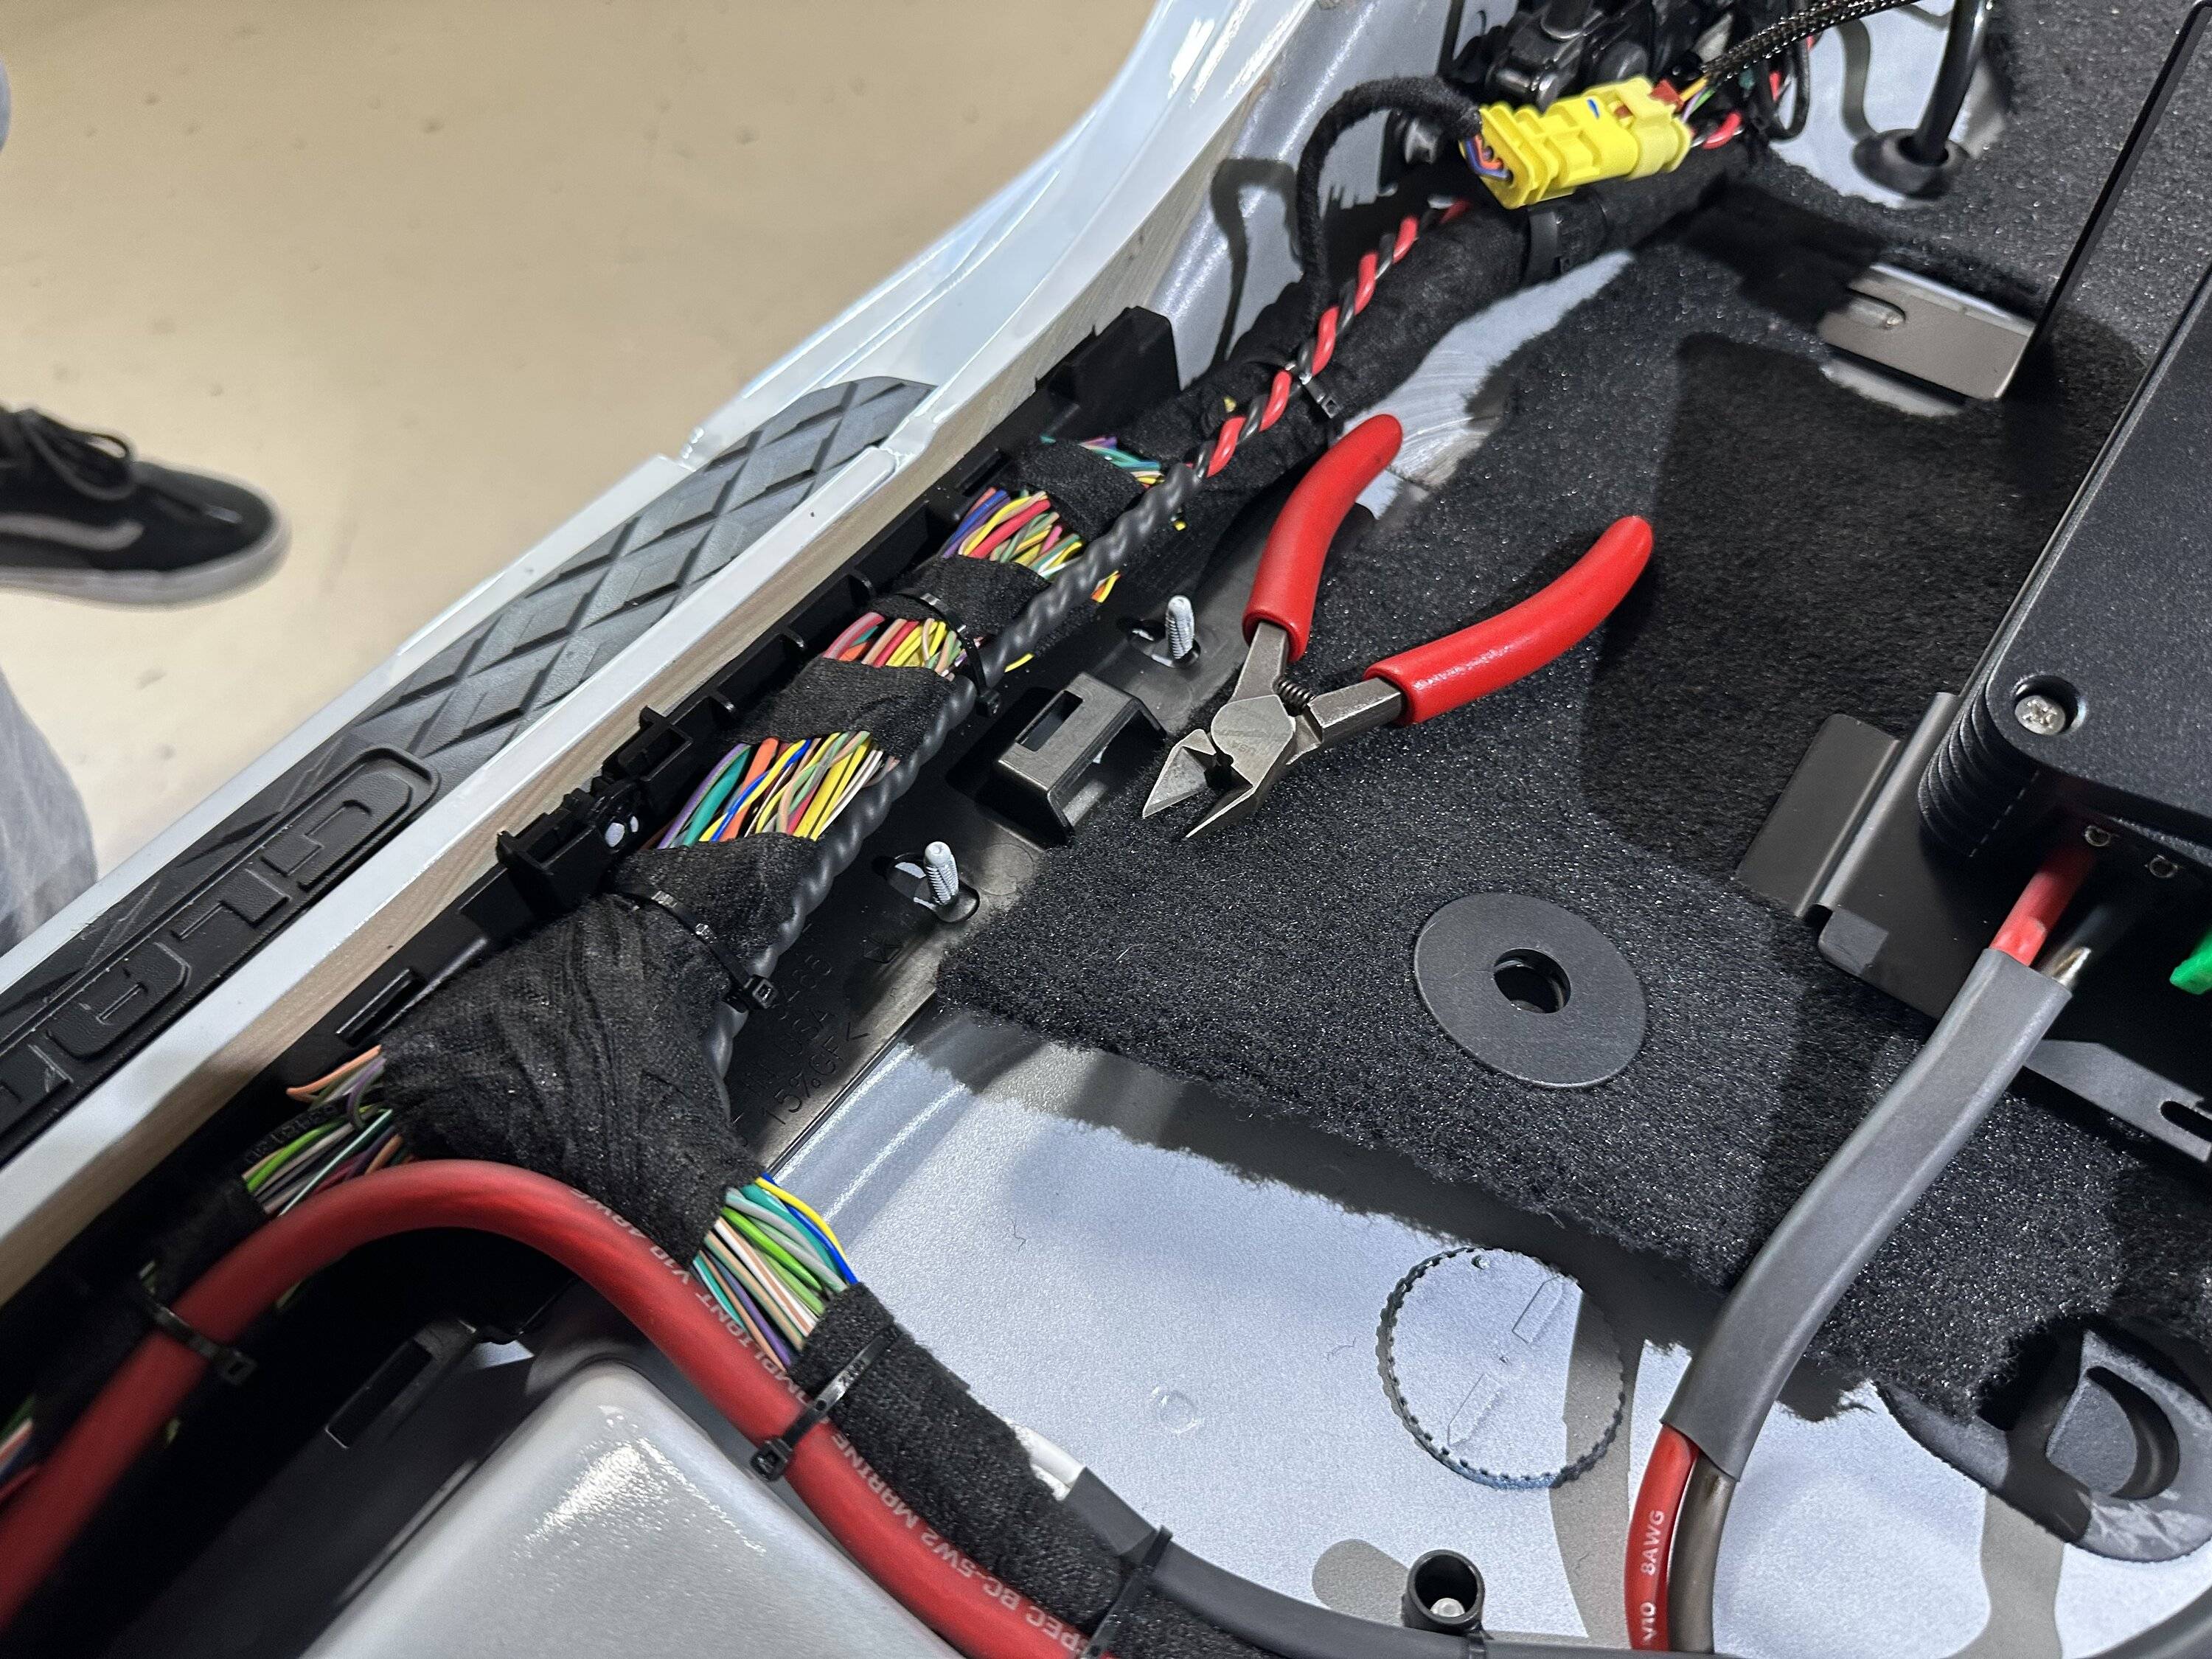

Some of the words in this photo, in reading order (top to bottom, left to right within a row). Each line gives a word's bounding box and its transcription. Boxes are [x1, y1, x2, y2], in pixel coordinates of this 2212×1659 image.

[695, 1292, 824, 1417] OMPLIANT
[830, 1433, 919, 1529] MARINE
[1640, 1509, 1665, 1576] 8AWG
